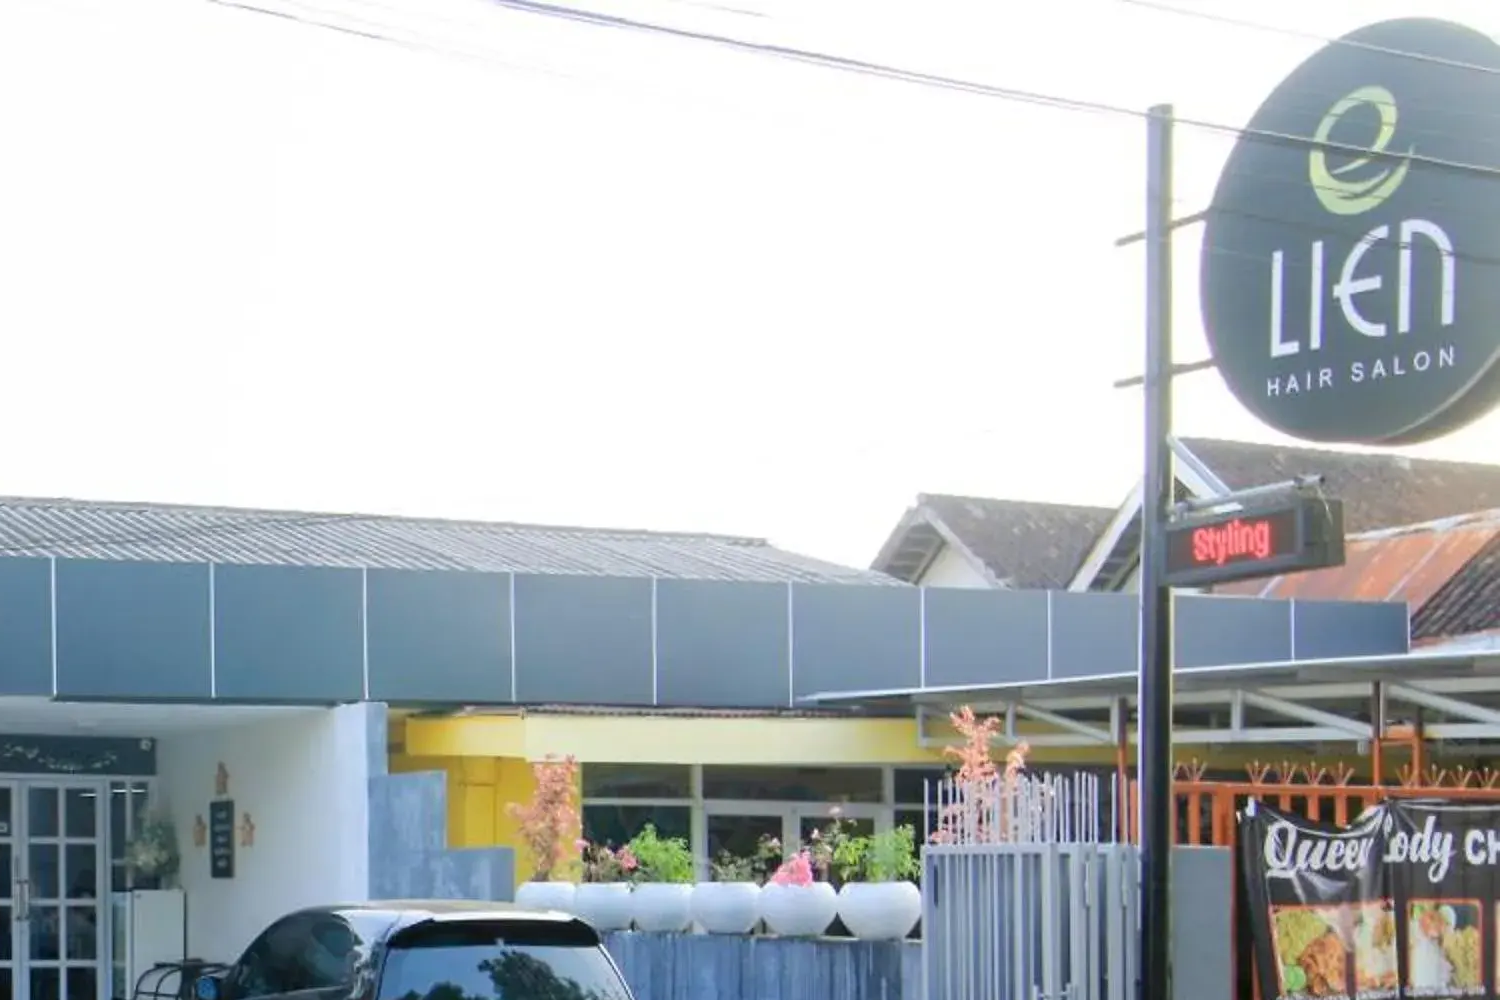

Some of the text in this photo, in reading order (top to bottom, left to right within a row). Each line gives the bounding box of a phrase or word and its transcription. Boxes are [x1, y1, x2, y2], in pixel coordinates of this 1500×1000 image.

[1267, 345, 1455, 397] HAIR SALON
[1193, 518, 1270, 566] Styling
